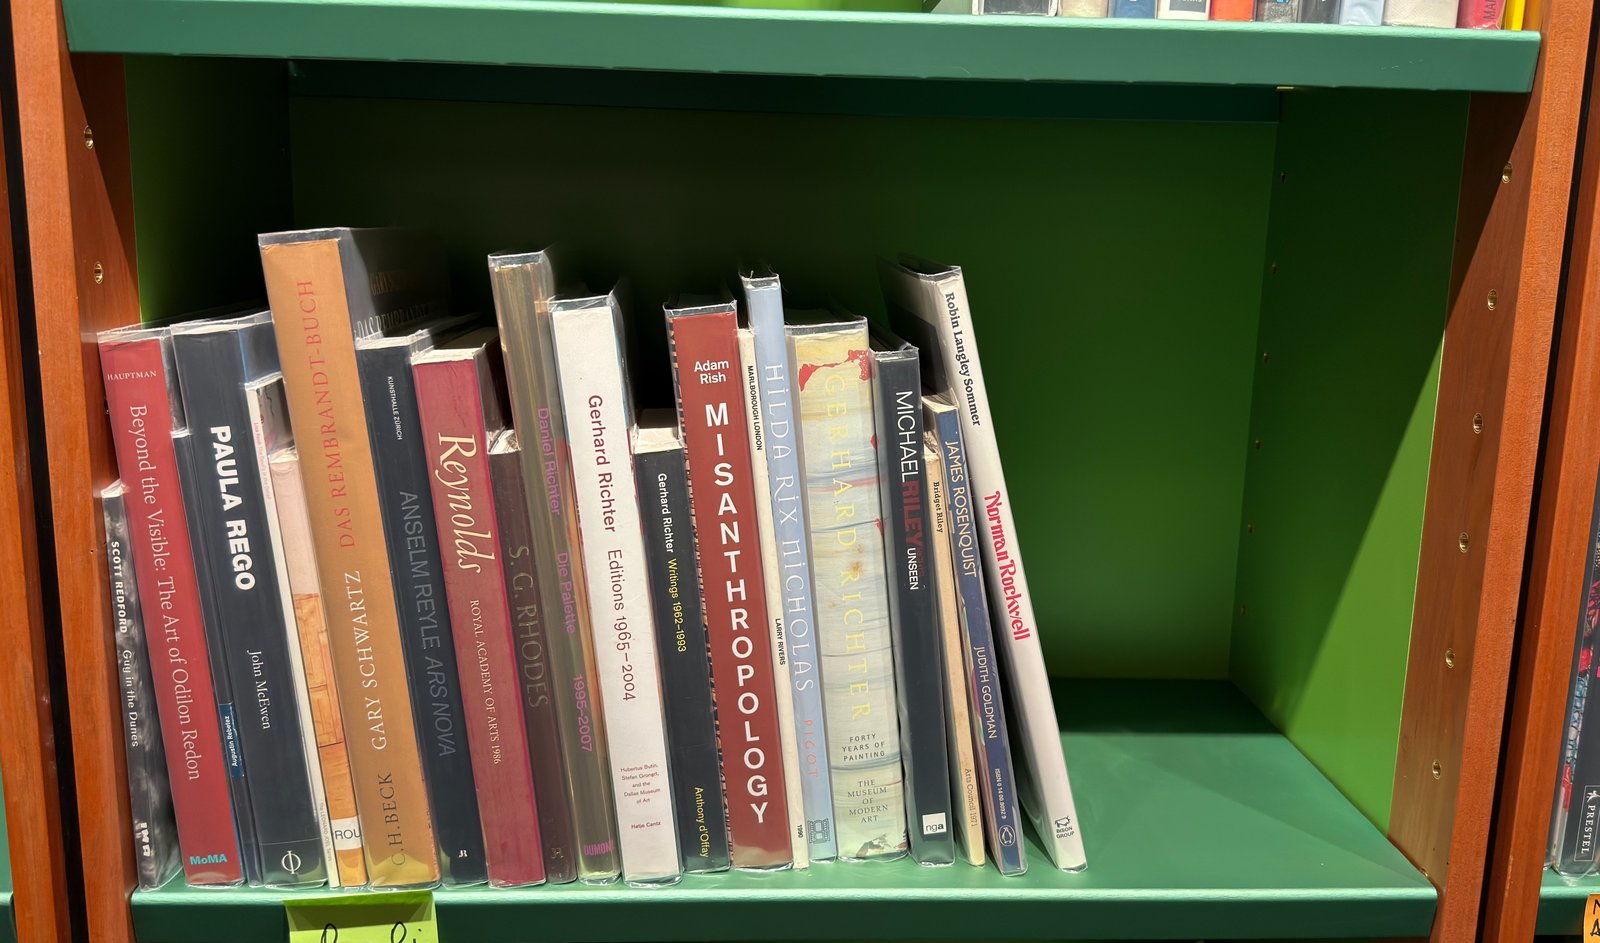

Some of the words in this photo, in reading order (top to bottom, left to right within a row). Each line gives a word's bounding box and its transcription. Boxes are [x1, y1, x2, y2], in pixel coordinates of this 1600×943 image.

[106, 370, 158, 381] HAUPTMAN
[694, 360, 730, 372] Adam
[699, 372, 727, 385] Rish
[945, 292, 960, 328] Robin
[953, 330, 970, 377] Langley
[963, 378, 981, 427] Sommer
[297, 280, 347, 498] REMBRANDT-BUCH
[387, 376, 400, 415] KUNSTHALLE
[747, 366, 759, 420] MARLBOROUGH
[753, 421, 763, 451] LONDON
[128, 404, 157, 472] Beyond
[392, 416, 403, 440] ZÜRICH
[537, 407, 555, 456] Daniel
[588, 395, 610, 466] Gerhard
[896, 390, 919, 483] MICHAEL
[209, 425, 244, 512] PAULA
[825, 374, 857, 547] GERHARD
[945, 441, 964, 483] JAMES
[141, 477, 157, 504] the
[435, 432, 496, 574] Reynolds
[545, 461, 561, 516] Richter
[598, 472, 617, 532] Richter
[657, 473, 671, 515] Gerhard
[933, 481, 942, 511] Bridget
[331, 506, 355, 549] DAS
[902, 481, 924, 544] RILEY
[936, 512, 944, 534] Riley
[952, 486, 977, 578] ROSENQUIST
[147, 508, 167, 571] Visible:
[226, 519, 257, 591] REGO
[399, 490, 431, 579] ANSELM
[662, 517, 675, 553] Richter
[111, 541, 124, 578] SCOTT
[556, 552, 568, 579] Die
[668, 558, 680, 599] Writings
[907, 547, 919, 590] UNSEEN
[984, 490, 1009, 562] Norman
[998, 558, 1031, 641] Rockwell
[157, 576, 172, 610] The
[608, 549, 625, 612] Editions
[115, 581, 128, 634] REDFORD
[413, 583, 441, 650] REYLE
[470, 599, 484, 640] ROYAL
[559, 581, 576, 634] Palette
[705, 402, 769, 824] MISANTHROPOLOGY
[163, 613, 180, 644] Art
[344, 569, 377, 688] SCHWARTZ
[775, 618, 784, 642] LARRY
[840, 567, 872, 720] RICHTER
[122, 649, 132, 676] Guy
[168, 646, 187, 664] of
[247, 649, 262, 678] John
[476, 640, 492, 694] ACADEMY
[517, 602, 549, 710] RHODES
[778, 643, 786, 666] RIVERS
[973, 646, 990, 683] JUDITH
[124, 679, 132, 689] in
[171, 668, 191, 725] Odilon
[425, 656, 449, 698] ARS
[126, 692, 135, 709] the
[254, 681, 271, 730] McEwen
[484, 695, 495, 714] OF
[980, 685, 998, 740] GOLDMAN
[129, 712, 140, 747] Dunes
[362, 696, 387, 750] GARY
[431, 702, 457, 757] NOVA
[487, 714, 500, 744] ARTS
[849, 733, 877, 743] FORTY
[181, 729, 201, 780] Redon
[229, 741, 238, 766] Augustin
[492, 745, 502, 765] 1986
[803, 719, 819, 778] PIGOT
[843, 751, 885, 762] PAINTING
[874, 741, 885, 749] OF
[847, 787, 888, 798] MUSEUM
[858, 779, 876, 787] THE
[967, 783, 976, 812] Council
[383, 771, 406, 866] C.H.BECK
[694, 787, 705, 823] Anthony
[849, 805, 889, 816] MODERN
[861, 815, 879, 824] ART
[925, 822, 945, 835] nga
[1056, 826, 1073, 834] BISON
[1056, 831, 1075, 839] GROUP
[1581, 804, 1596, 855] PRESTEL
[189, 853, 228, 865] MoMA
